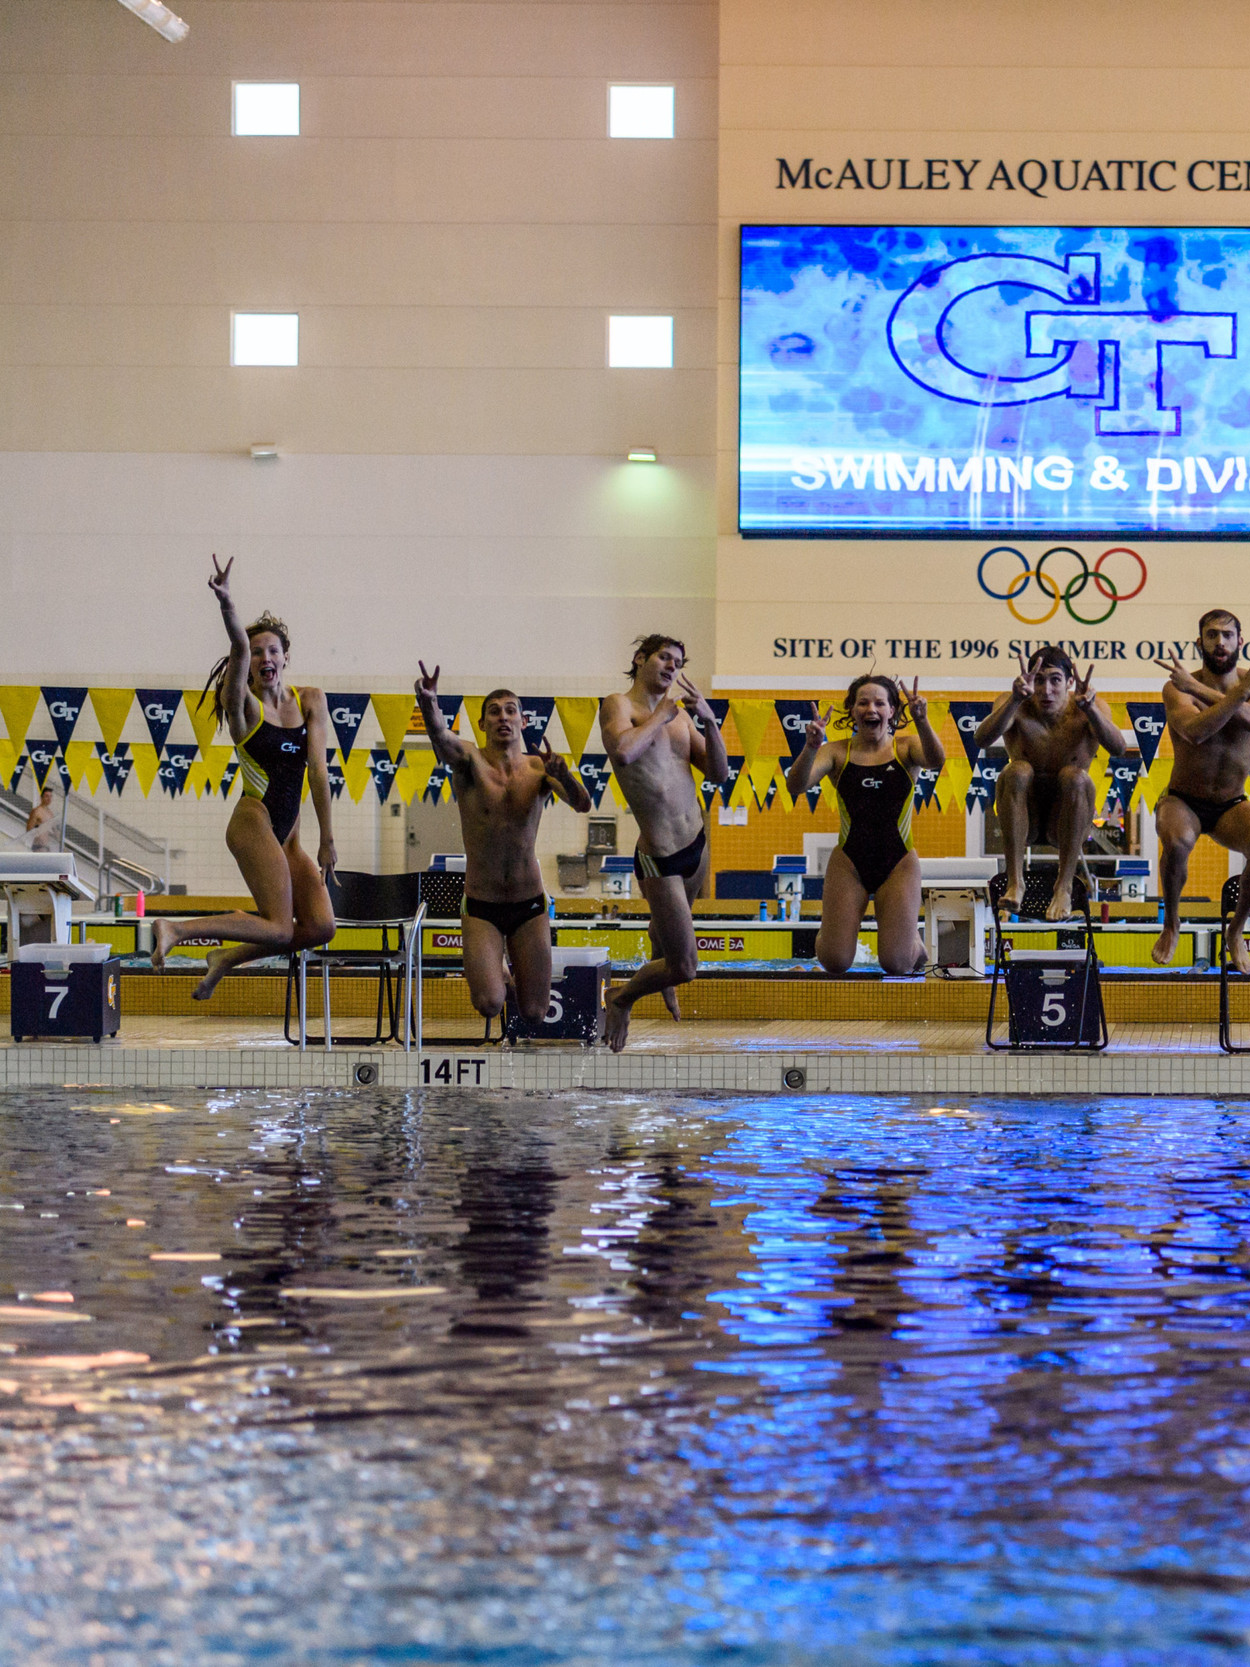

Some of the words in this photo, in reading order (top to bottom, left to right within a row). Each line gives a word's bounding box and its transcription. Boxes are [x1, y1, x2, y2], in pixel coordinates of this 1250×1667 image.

[775, 158, 982, 190] McAULEY
[986, 159, 1177, 198] AQUATIC
[886, 252, 1237, 436] GT
[791, 453, 1074, 492] SWIMMING
[1090, 455, 1130, 491] &
[773, 637, 833, 658] SITE
[839, 638, 876, 658] OF
[885, 639, 941, 659] THE
[950, 639, 999, 659] 1996
[1128, 883, 1138, 897] 6
[697, 937, 744, 950] OMEGA
[44, 986, 69, 1019] 7
[543, 990, 563, 1023] 6
[1040, 993, 1066, 1027] 5
[420, 1059, 452, 1084] 14
[456, 1060, 486, 1084] FT
